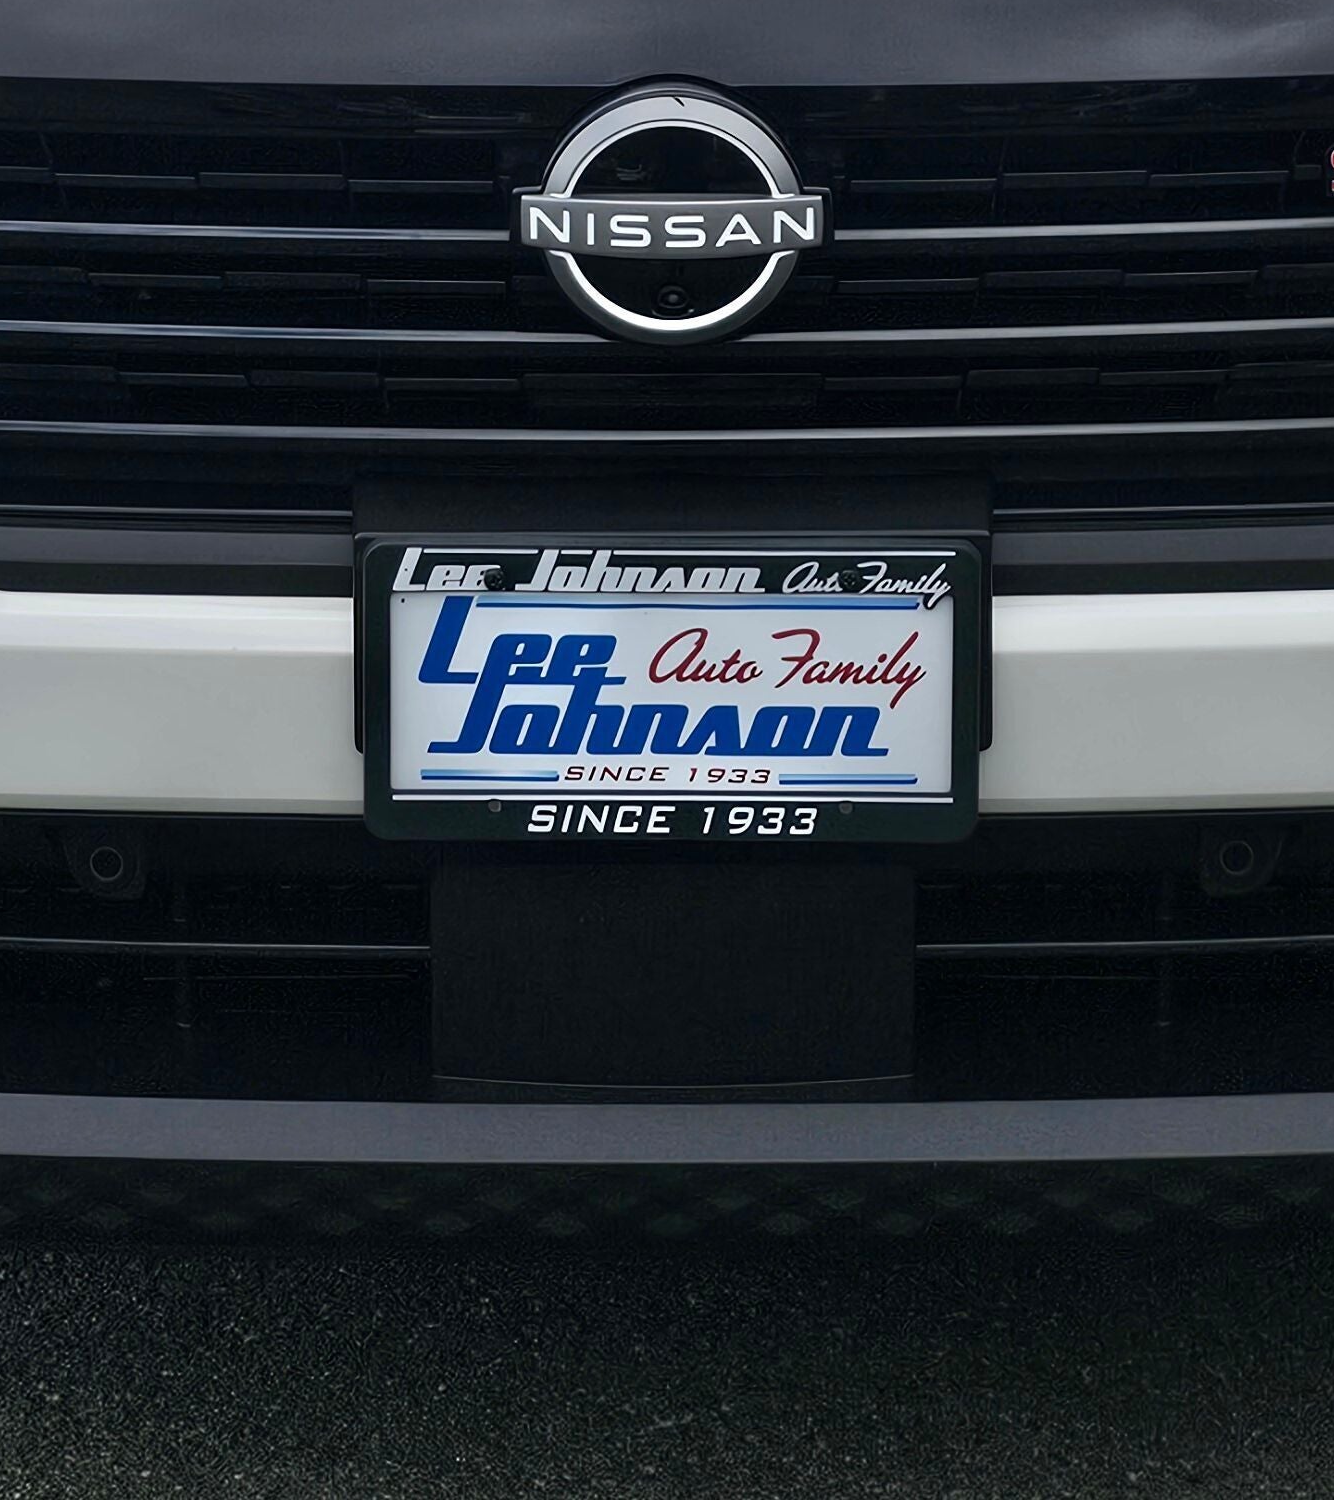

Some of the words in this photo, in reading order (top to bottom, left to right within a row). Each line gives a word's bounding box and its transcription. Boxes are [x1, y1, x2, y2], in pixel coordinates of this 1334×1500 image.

[529, 206, 815, 248] NISSAN
[514, 549, 765, 593] Johnson
[782, 561, 857, 593] Aut
[857, 561, 951, 608] Family
[418, 596, 627, 685] Lee
[649, 628, 763, 683] Auto
[771, 628, 927, 709] Family
[427, 668, 889, 757] Johnson
[564, 766, 670, 782] SINCE
[689, 767, 771, 784] 1933
[527, 804, 676, 833] SINCE
[703, 806, 817, 835] 1933
